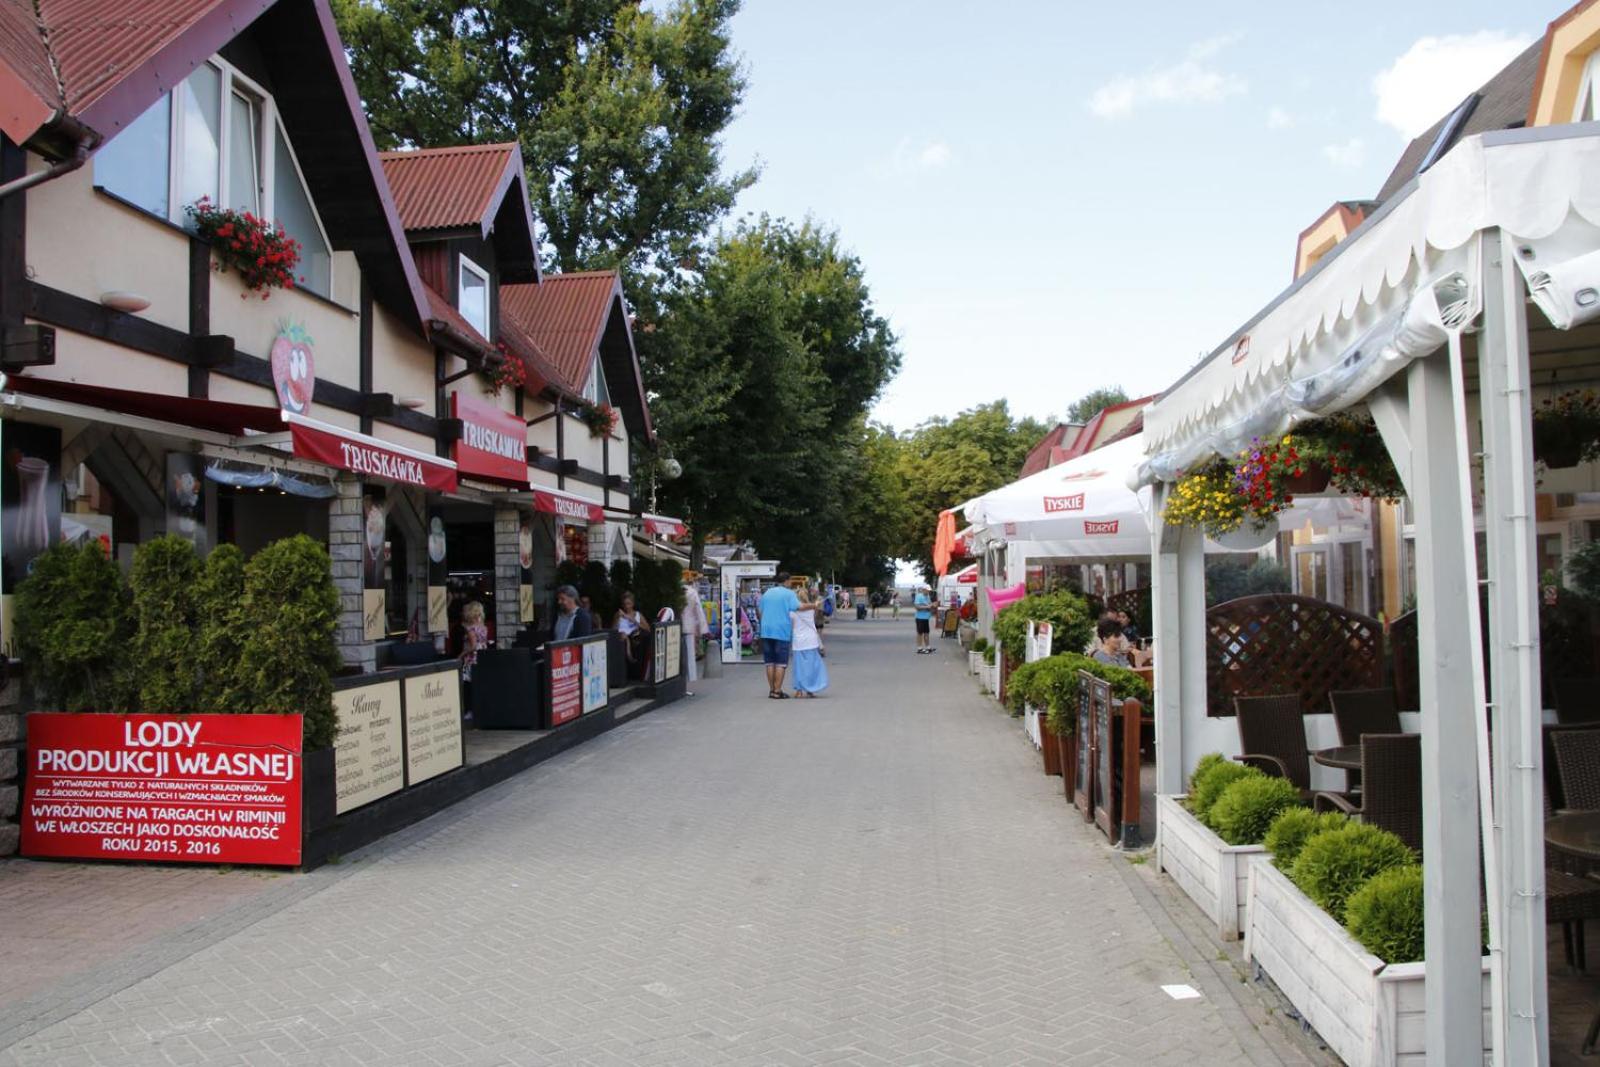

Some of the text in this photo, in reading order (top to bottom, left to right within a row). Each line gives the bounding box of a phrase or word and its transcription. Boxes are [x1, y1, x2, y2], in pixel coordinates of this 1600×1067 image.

[463, 420, 526, 463] TRUSKAWKA
[341, 441, 426, 485] TRUSKAWKA
[1046, 495, 1082, 511] TYSKIE
[351, 693, 381, 719] Kawy
[125, 721, 202, 748] LODY
[38, 749, 294, 780] PRODUKCJI WŁASNEJ
[35, 788, 50, 797] BEZ
[52, 788, 94, 798] ŚRODKÓW
[95, 790, 173, 800] KONSERWUJĄCYCH
[178, 792, 242, 802] WZMACNIACZY
[243, 793, 285, 803] SMAKÓW
[52, 780, 267, 792] WYTWARZANE TYLKO Z NATURALNYCH SKŁADNIKÓW
[31, 802, 286, 824] WYRÓŻNIONE NA TARGACH W RIMINII
[35, 821, 279, 840] WE WŁOSZECH JAKO DOSKONAŁOŚĆ
[102, 838, 221, 855] ROKU 2015, 2016
